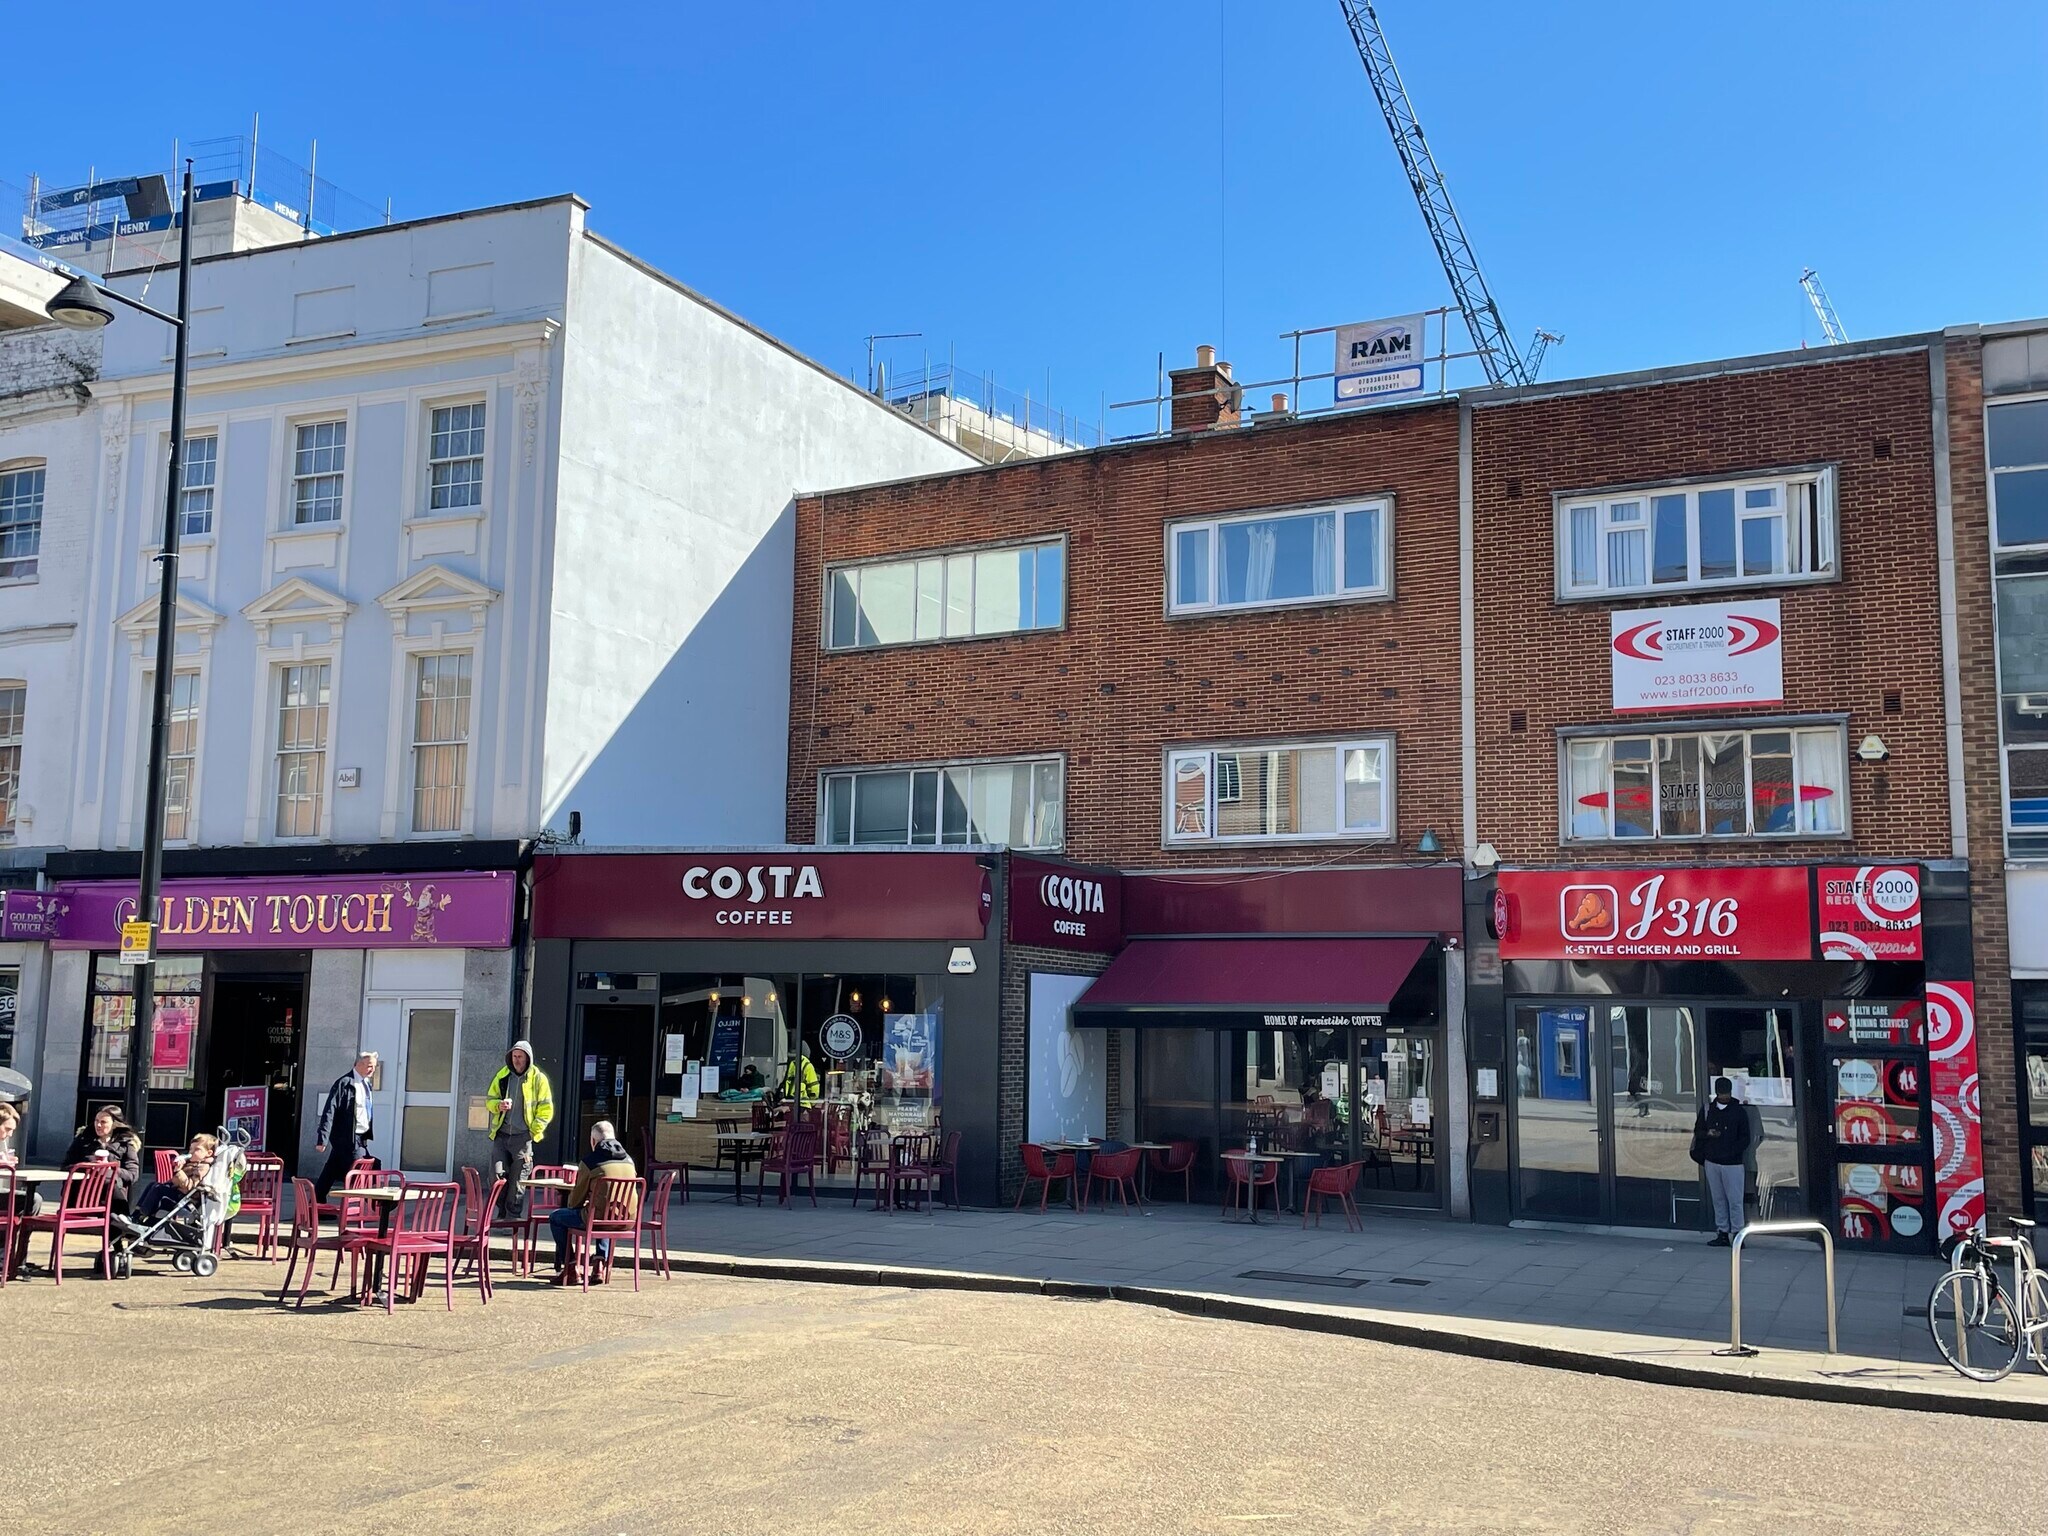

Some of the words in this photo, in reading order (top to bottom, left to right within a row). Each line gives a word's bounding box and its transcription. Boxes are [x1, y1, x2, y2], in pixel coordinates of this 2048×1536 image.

[120, 220, 151, 235] HENRY
[57, 230, 85, 244] HENRY
[1351, 334, 1411, 359] RAM
[1666, 628, 1696, 641] STAFF
[1699, 626, 1724, 639] 2000
[1666, 641, 1699, 651] RECRUITMENT
[1703, 640, 1725, 649] TRAINING
[1654, 675, 1676, 686] 023
[1679, 673, 1707, 684] 8033
[1710, 672, 1738, 682] 8633
[1640, 684, 1755, 700] www.staff2000.info
[338, 772, 355, 782] Abel
[1660, 783, 1699, 799] STAFF
[1705, 782, 1745, 798] 2000
[1660, 799, 1746, 812] RECRUTMENT
[682, 866, 825, 903] COSTA
[1826, 880, 1871, 894] STAFF
[1876, 881, 1913, 893] 2000
[1041, 874, 1104, 915] COSTA
[1826, 895, 1914, 905] RECRUITMENT
[113, 895, 258, 934] GLDEN
[266, 894, 395, 934] TOUCH
[1625, 874, 1739, 941] J316
[10, 913, 45, 923] GOLDEN
[715, 910, 793, 925] COFFEE
[12, 922, 41, 932] TOUCH
[1053, 919, 1086, 936] COFFEE
[1828, 921, 1849, 931] 023
[1854, 921, 1880, 931] 8033
[1885, 920, 1913, 931] 8633
[1565, 945, 1614, 955] K-STYLE
[1617, 945, 1671, 955] CHICKEN
[1674, 945, 1701, 955] AND
[1704, 945, 1741, 955] GRILL
[1872, 1005, 1888, 1016] CARE
[1264, 1015, 1287, 1026] HOME
[1287, 1015, 1298, 1026] OF
[1300, 1015, 1350, 1026] irresistible
[1351, 1015, 1382, 1026] COFFEE
[1879, 1018, 1909, 1028] SERVICES
[267, 1026, 294, 1036] GOLDEN
[830, 1030, 851, 1039] M&S
[269, 1036, 292, 1044] TOUCH
